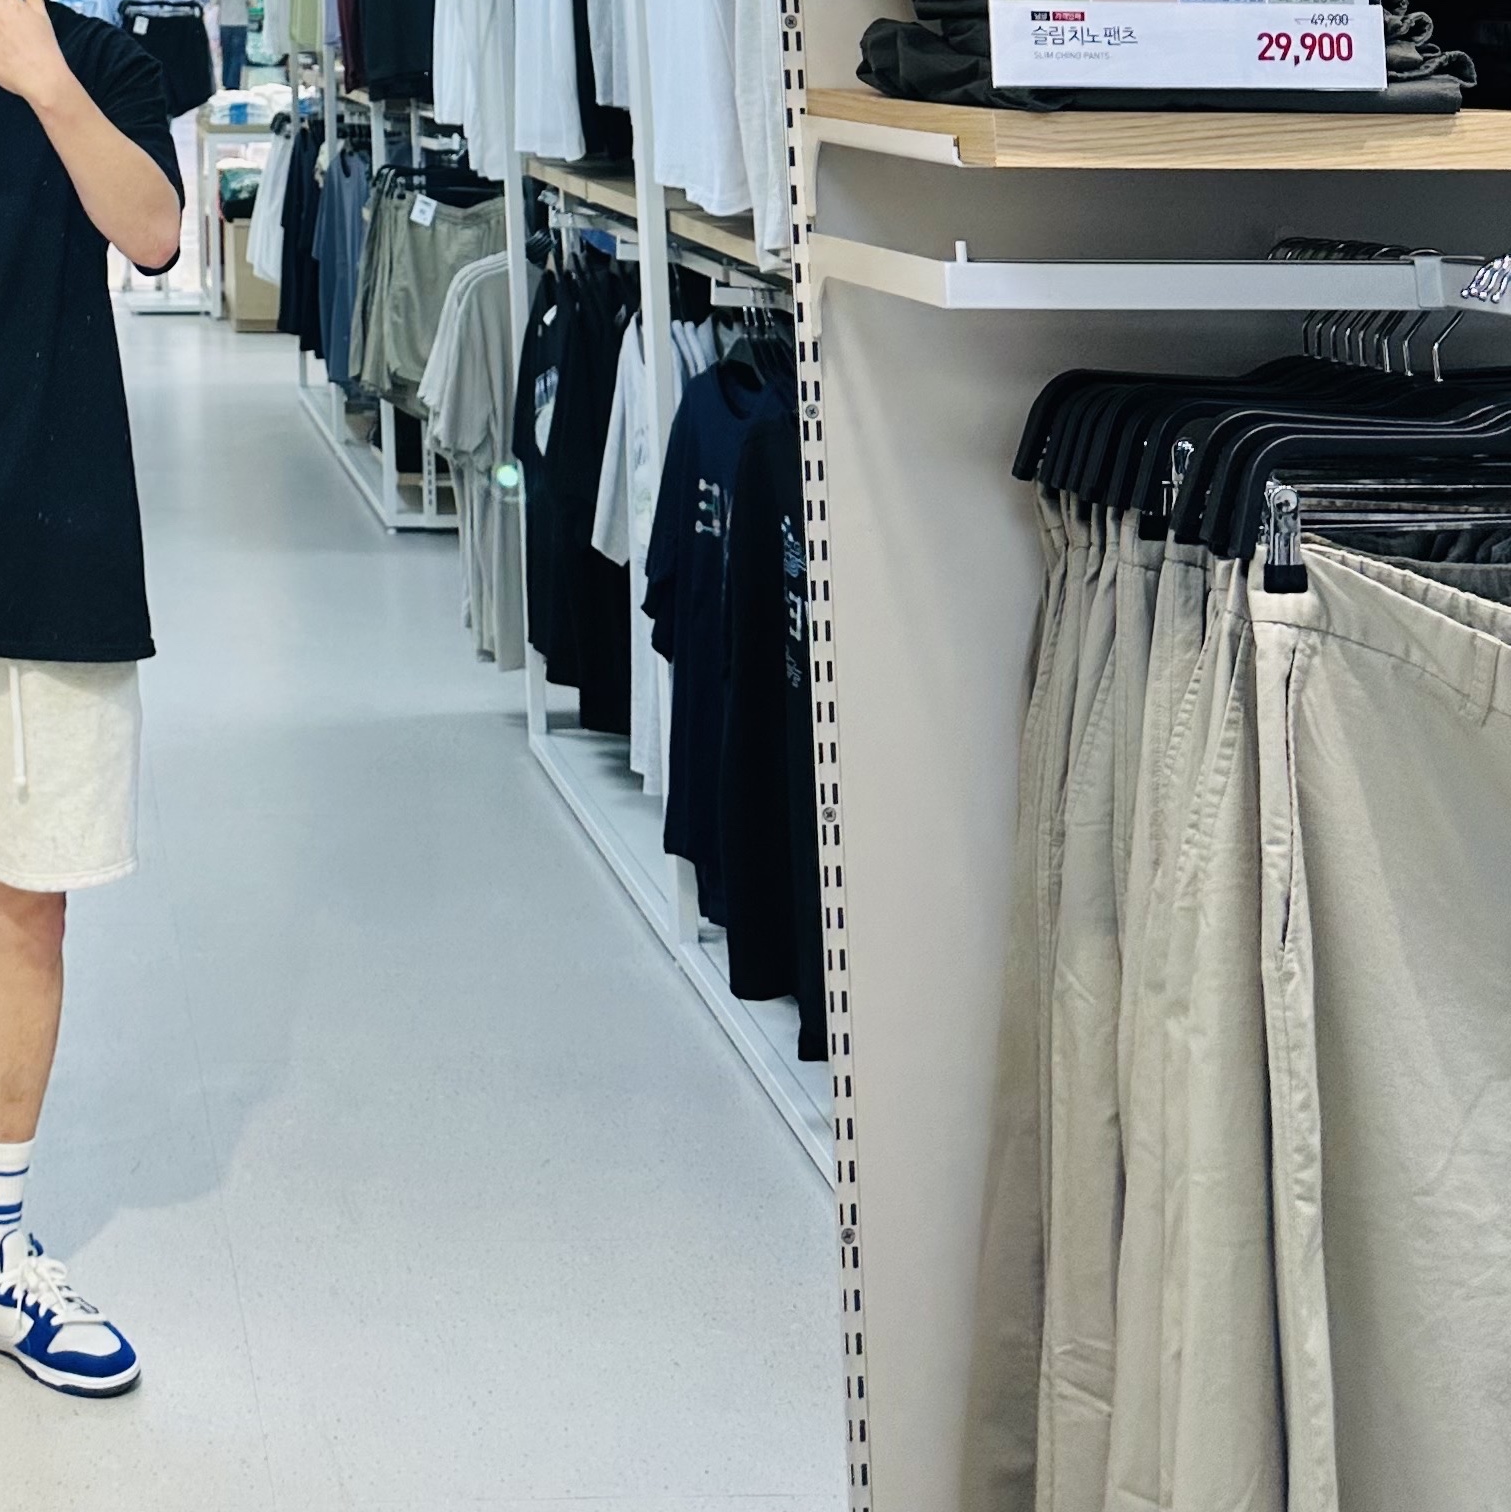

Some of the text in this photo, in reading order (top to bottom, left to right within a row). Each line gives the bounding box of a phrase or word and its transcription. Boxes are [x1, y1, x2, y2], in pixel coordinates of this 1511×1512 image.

[1311, 13, 1349, 27] 49,900
[1031, 25, 1065, 46] 슬림
[1103, 25, 1139, 46] 팬츠
[1034, 51, 1054, 60] SLIM
[1083, 51, 1111, 60] PANTS
[1256, 32, 1354, 67] 29,900
